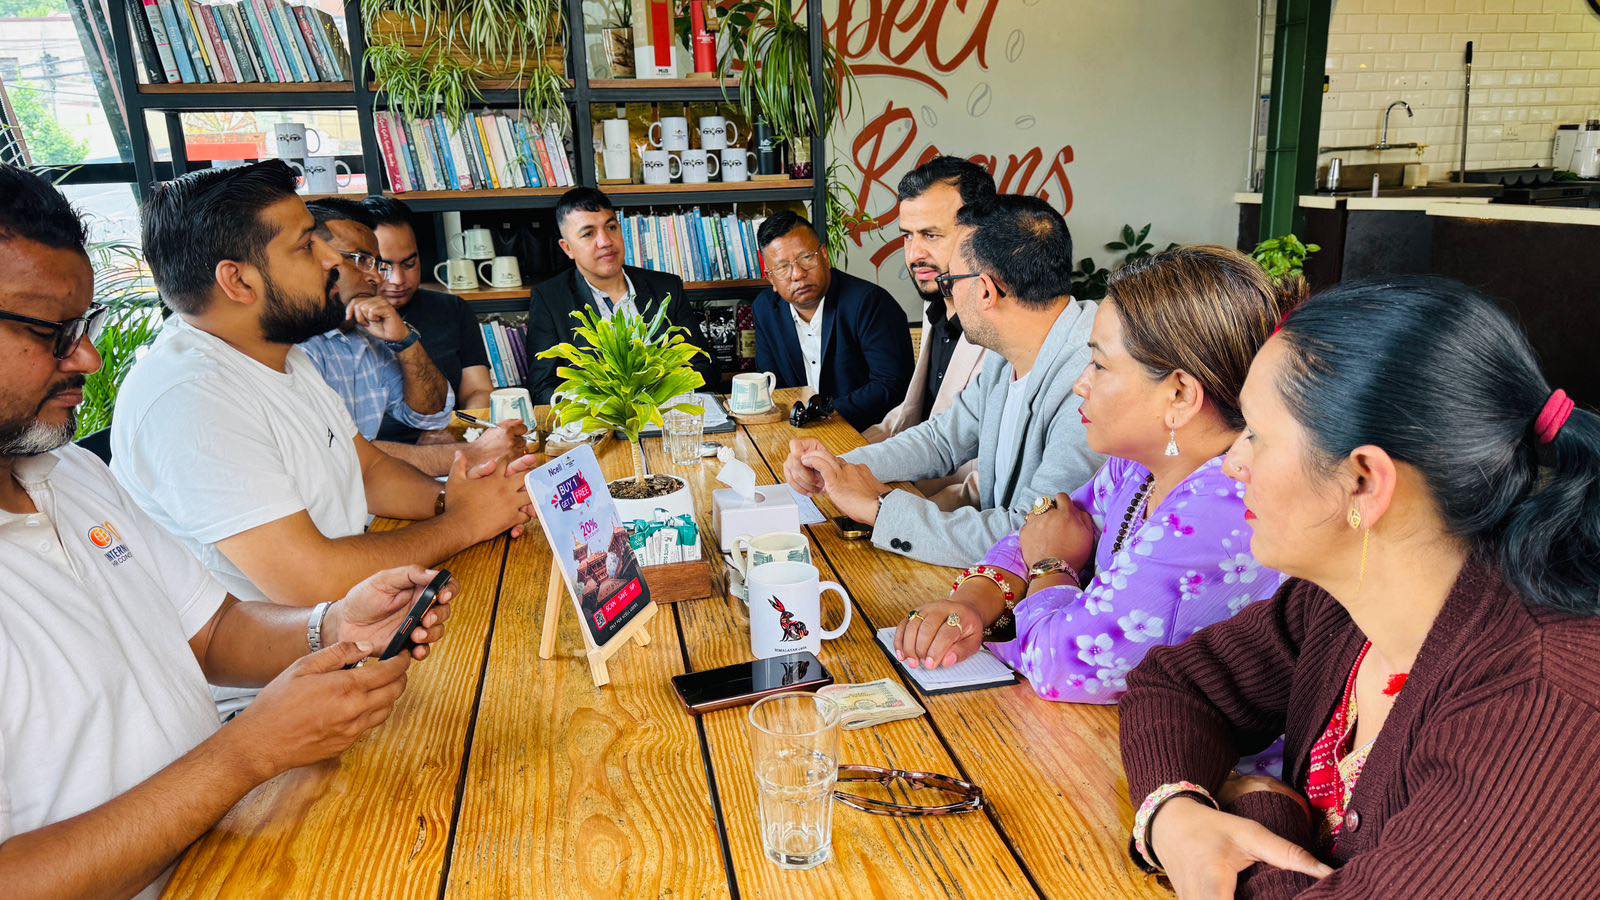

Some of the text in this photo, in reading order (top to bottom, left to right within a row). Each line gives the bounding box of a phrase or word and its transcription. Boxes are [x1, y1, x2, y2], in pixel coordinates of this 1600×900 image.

[847, 100, 1074, 247] Bns
[548, 463, 563, 477] Ncell
[559, 480, 573, 495] BUY
[575, 485, 590, 499] FREE
[580, 518, 598, 537] 20%
[605, 600, 617, 612] SCAN
[618, 589, 629, 600] SAVE
